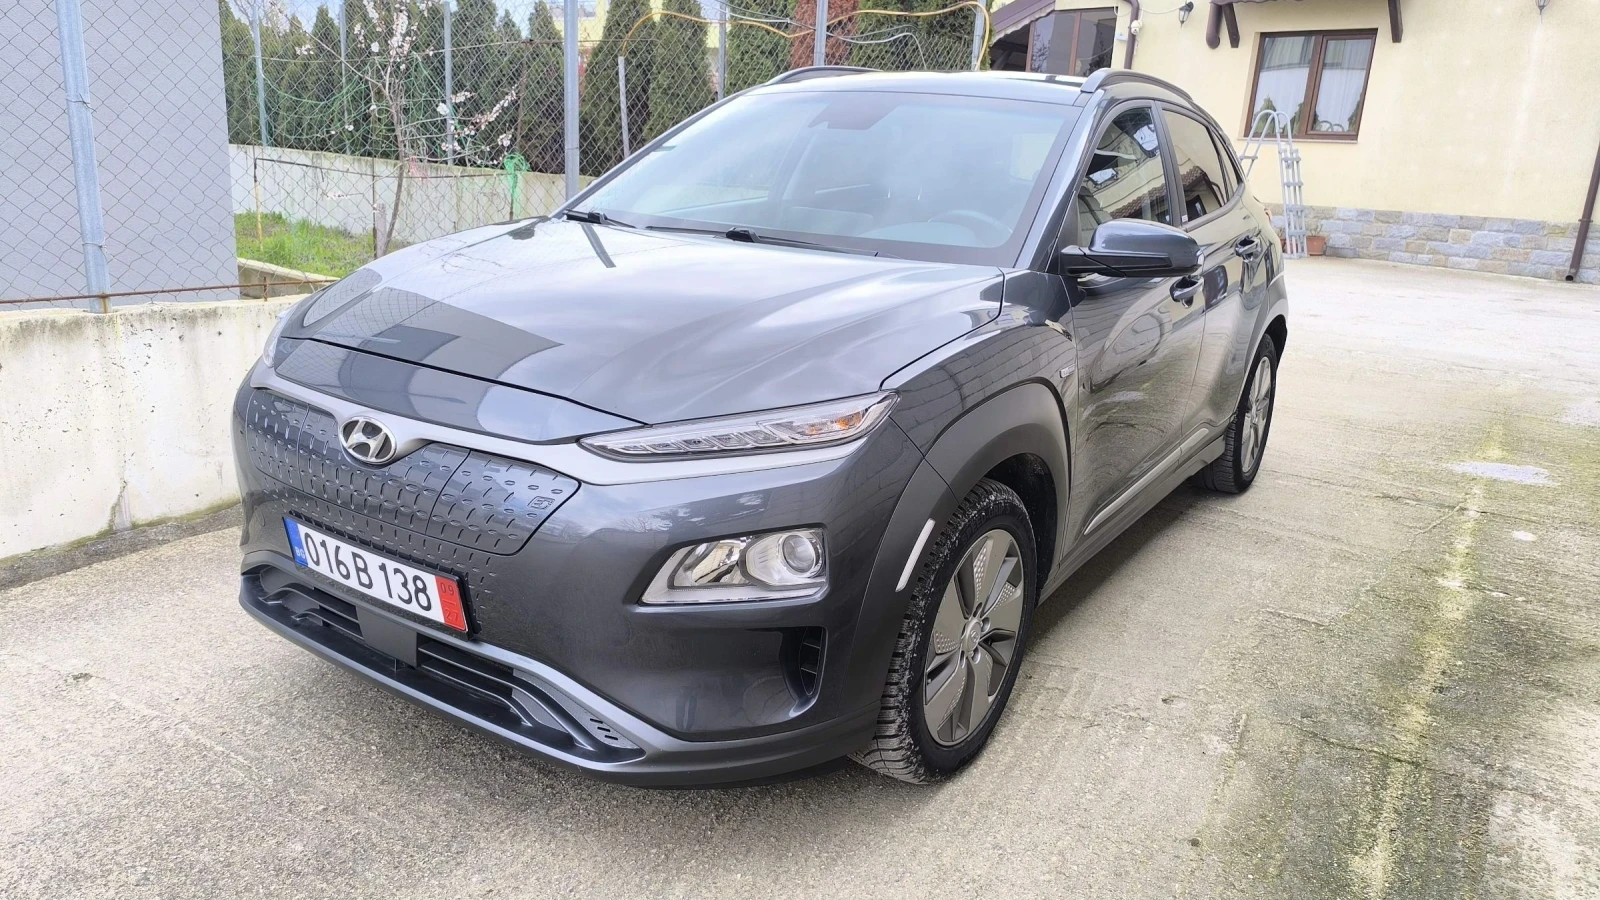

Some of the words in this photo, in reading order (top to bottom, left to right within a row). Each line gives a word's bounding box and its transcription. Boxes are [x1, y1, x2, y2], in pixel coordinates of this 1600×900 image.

[294, 546, 305, 559] BG
[440, 582, 454, 596] 09
[445, 607, 459, 622] 27
